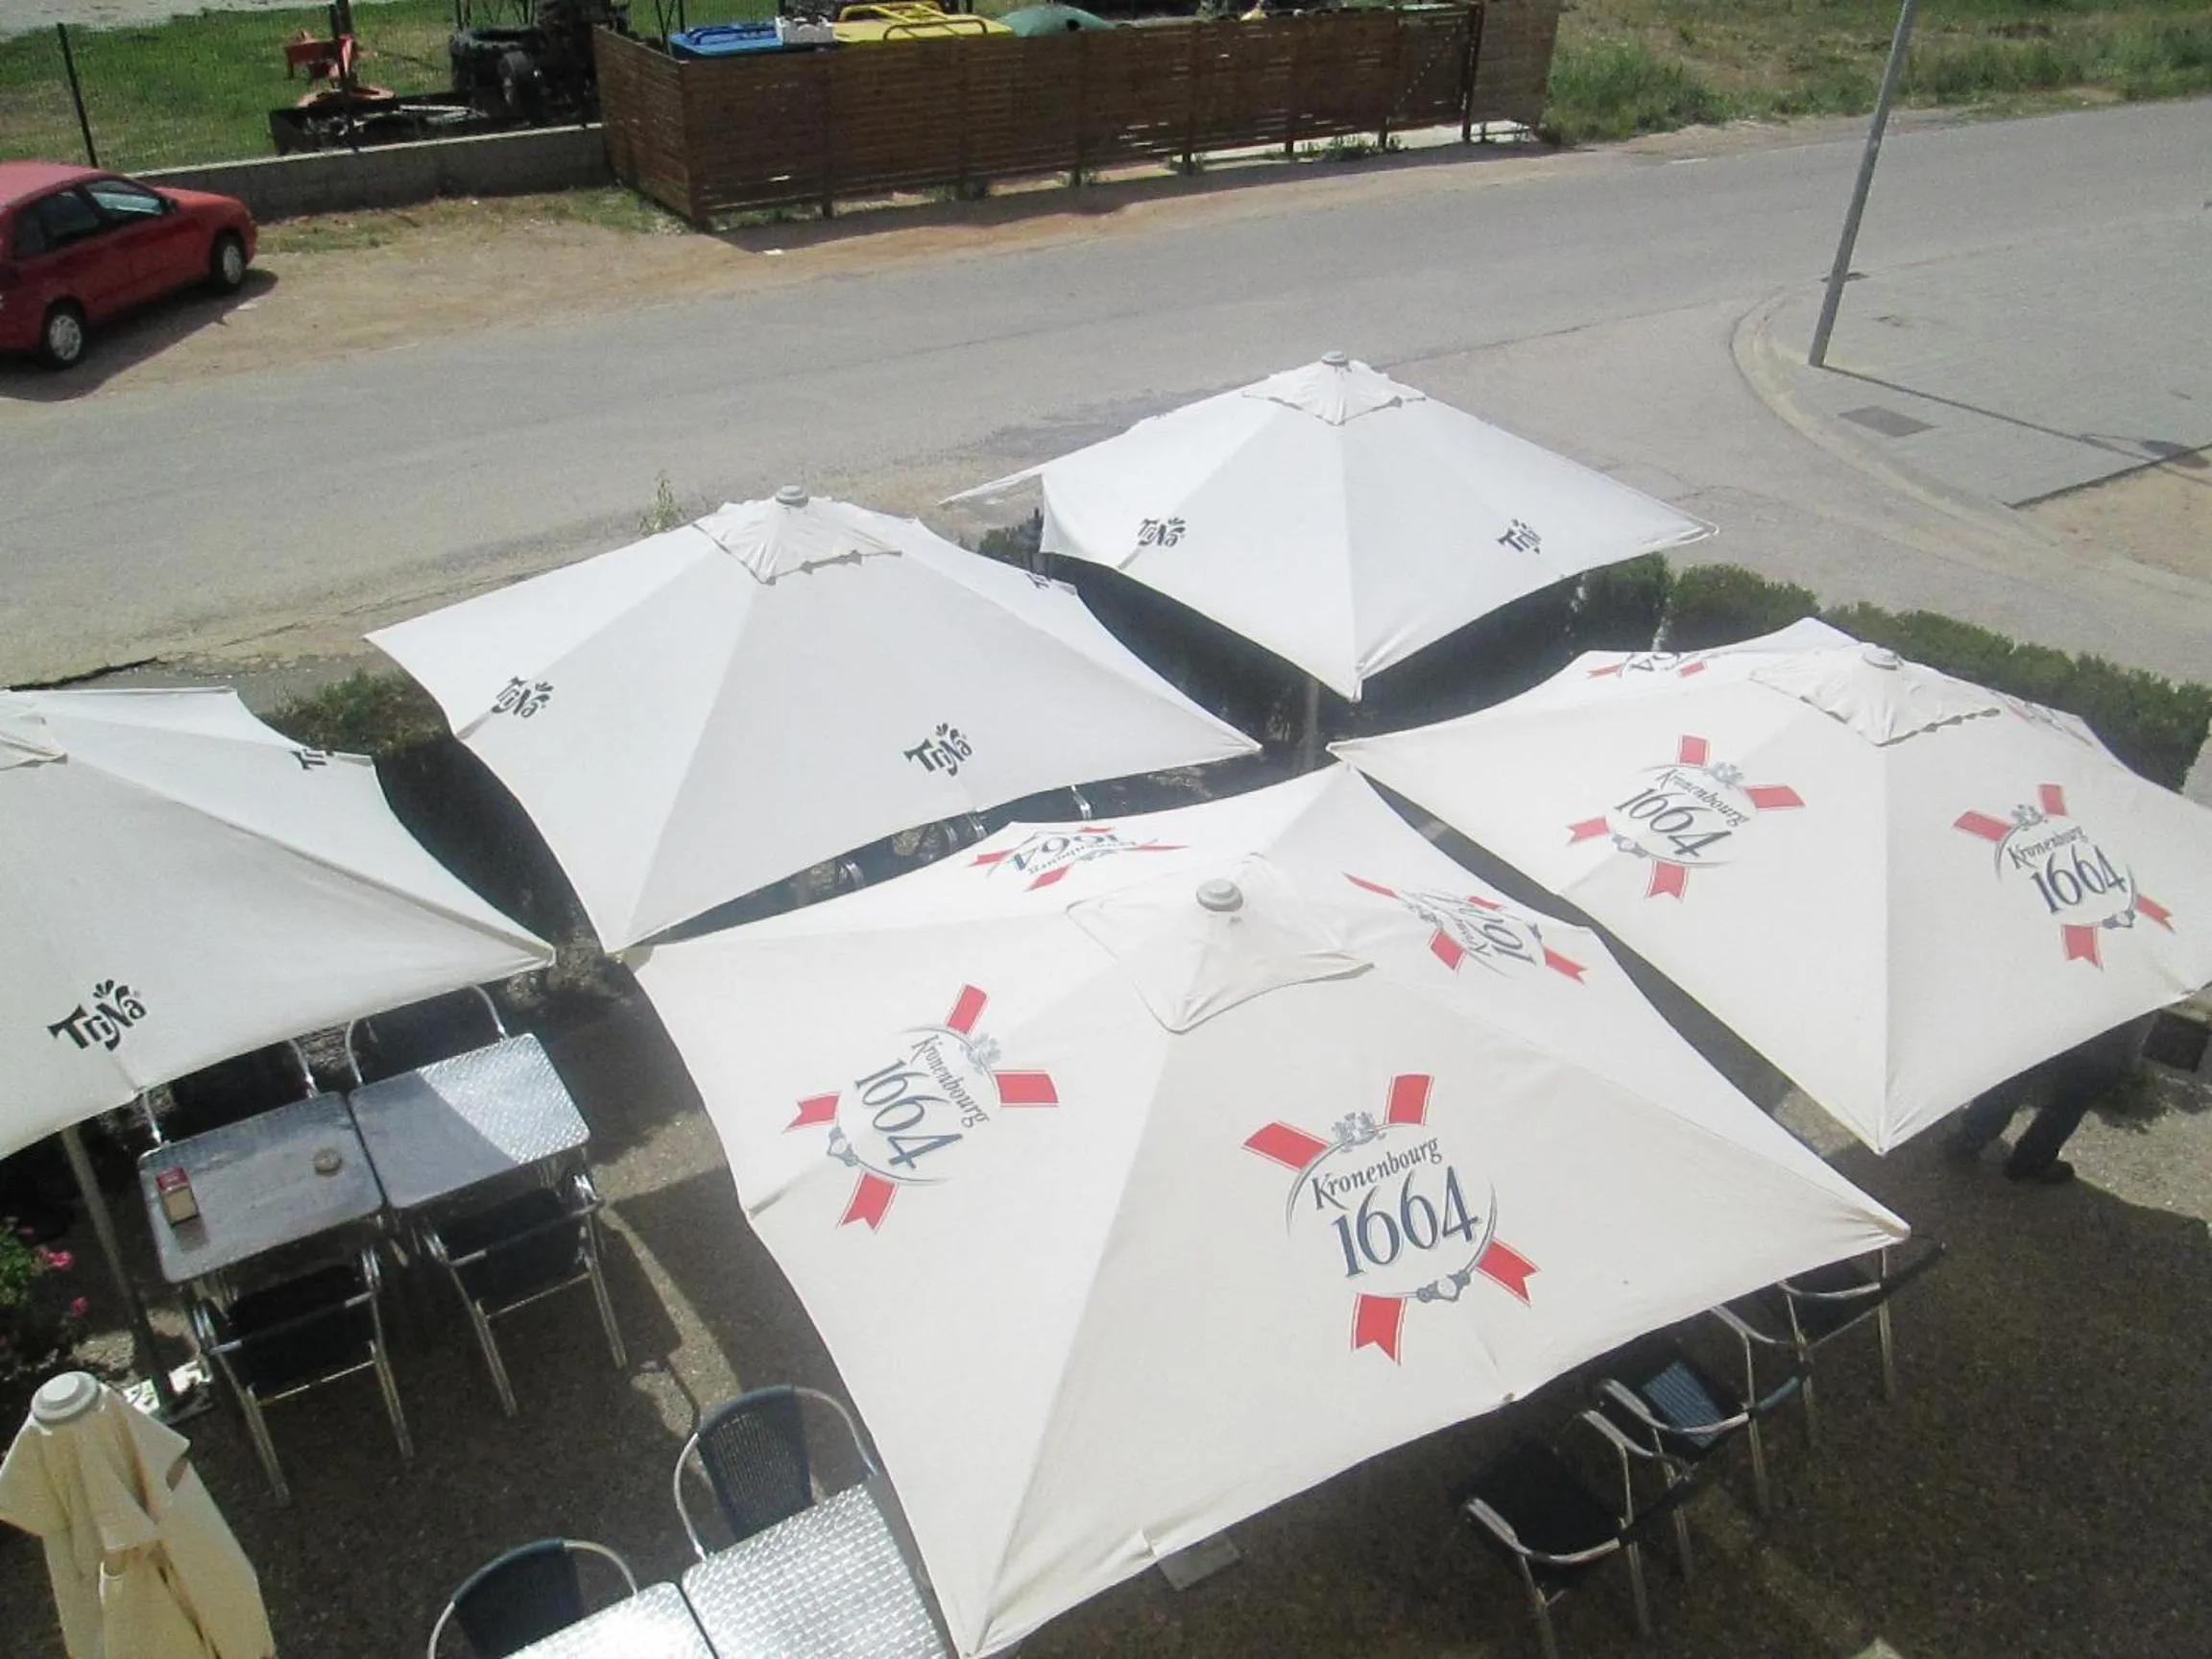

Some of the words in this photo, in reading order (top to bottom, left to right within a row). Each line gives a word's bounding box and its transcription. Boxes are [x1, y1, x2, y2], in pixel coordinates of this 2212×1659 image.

[1614, 788, 1732, 856] 1664
[1655, 768, 1751, 827] Kronenbourg
[2008, 826, 2088, 869] Kronenbourg
[2030, 844, 2128, 914] 1664
[854, 1058, 963, 1169] 1664
[910, 1034, 990, 1128] Kronenbourg
[1311, 1137, 1443, 1211] Kronenbourg
[1332, 1166, 1482, 1279] 1664
